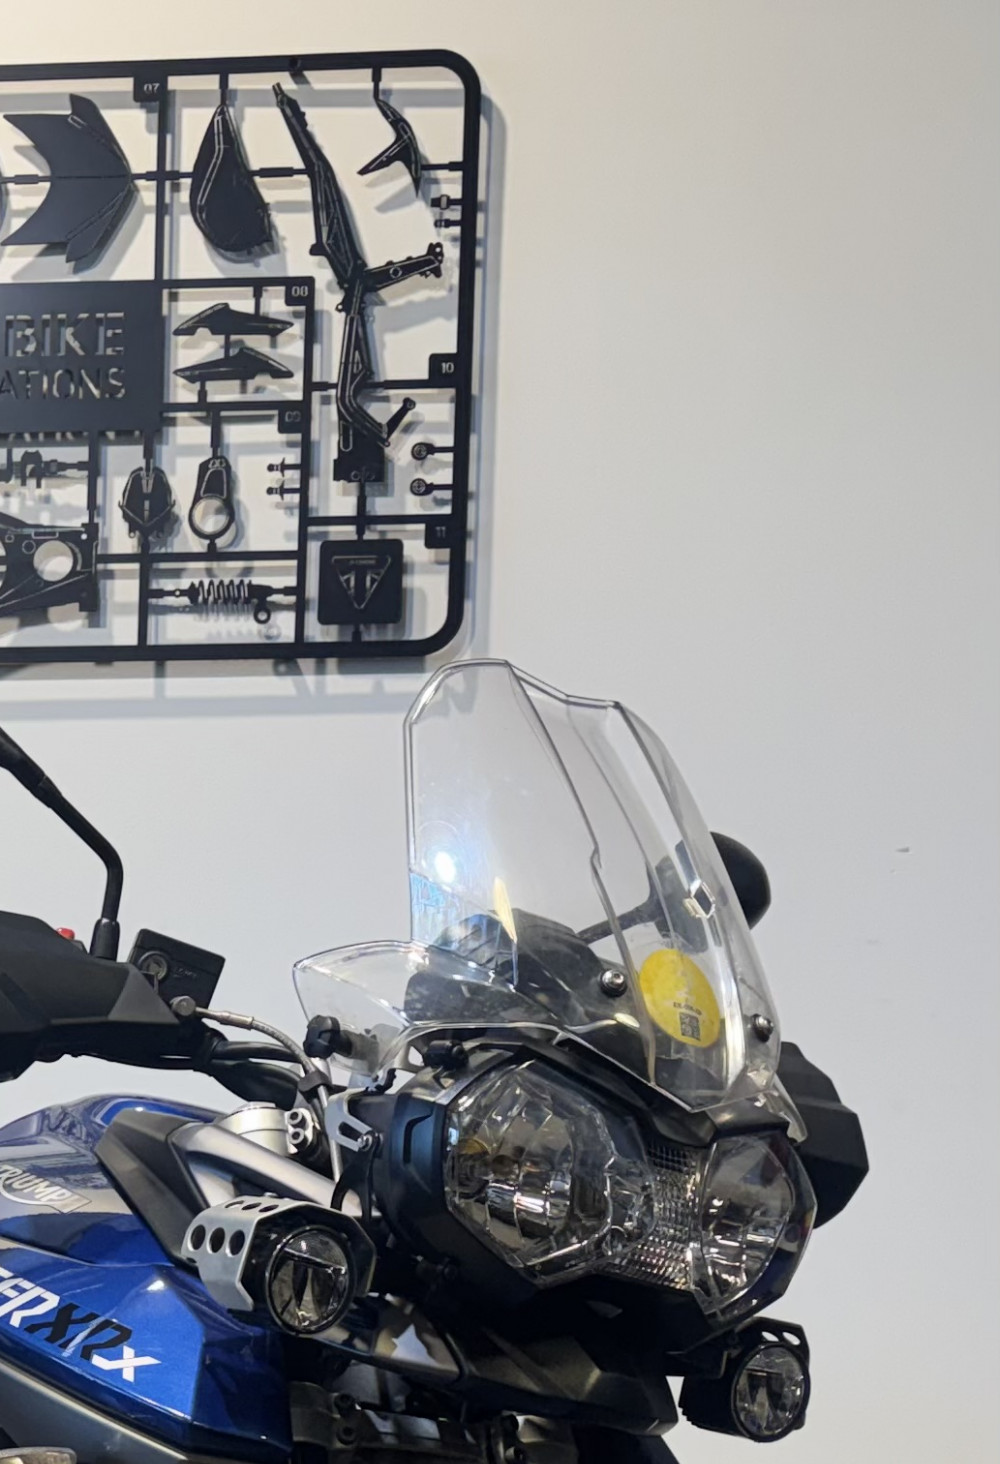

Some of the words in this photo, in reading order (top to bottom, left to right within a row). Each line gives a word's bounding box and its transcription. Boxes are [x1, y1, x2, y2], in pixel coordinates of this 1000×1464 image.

[143, 82, 160, 94] 07
[4, 311, 125, 358] BIKE
[441, 361, 455, 374] 10
